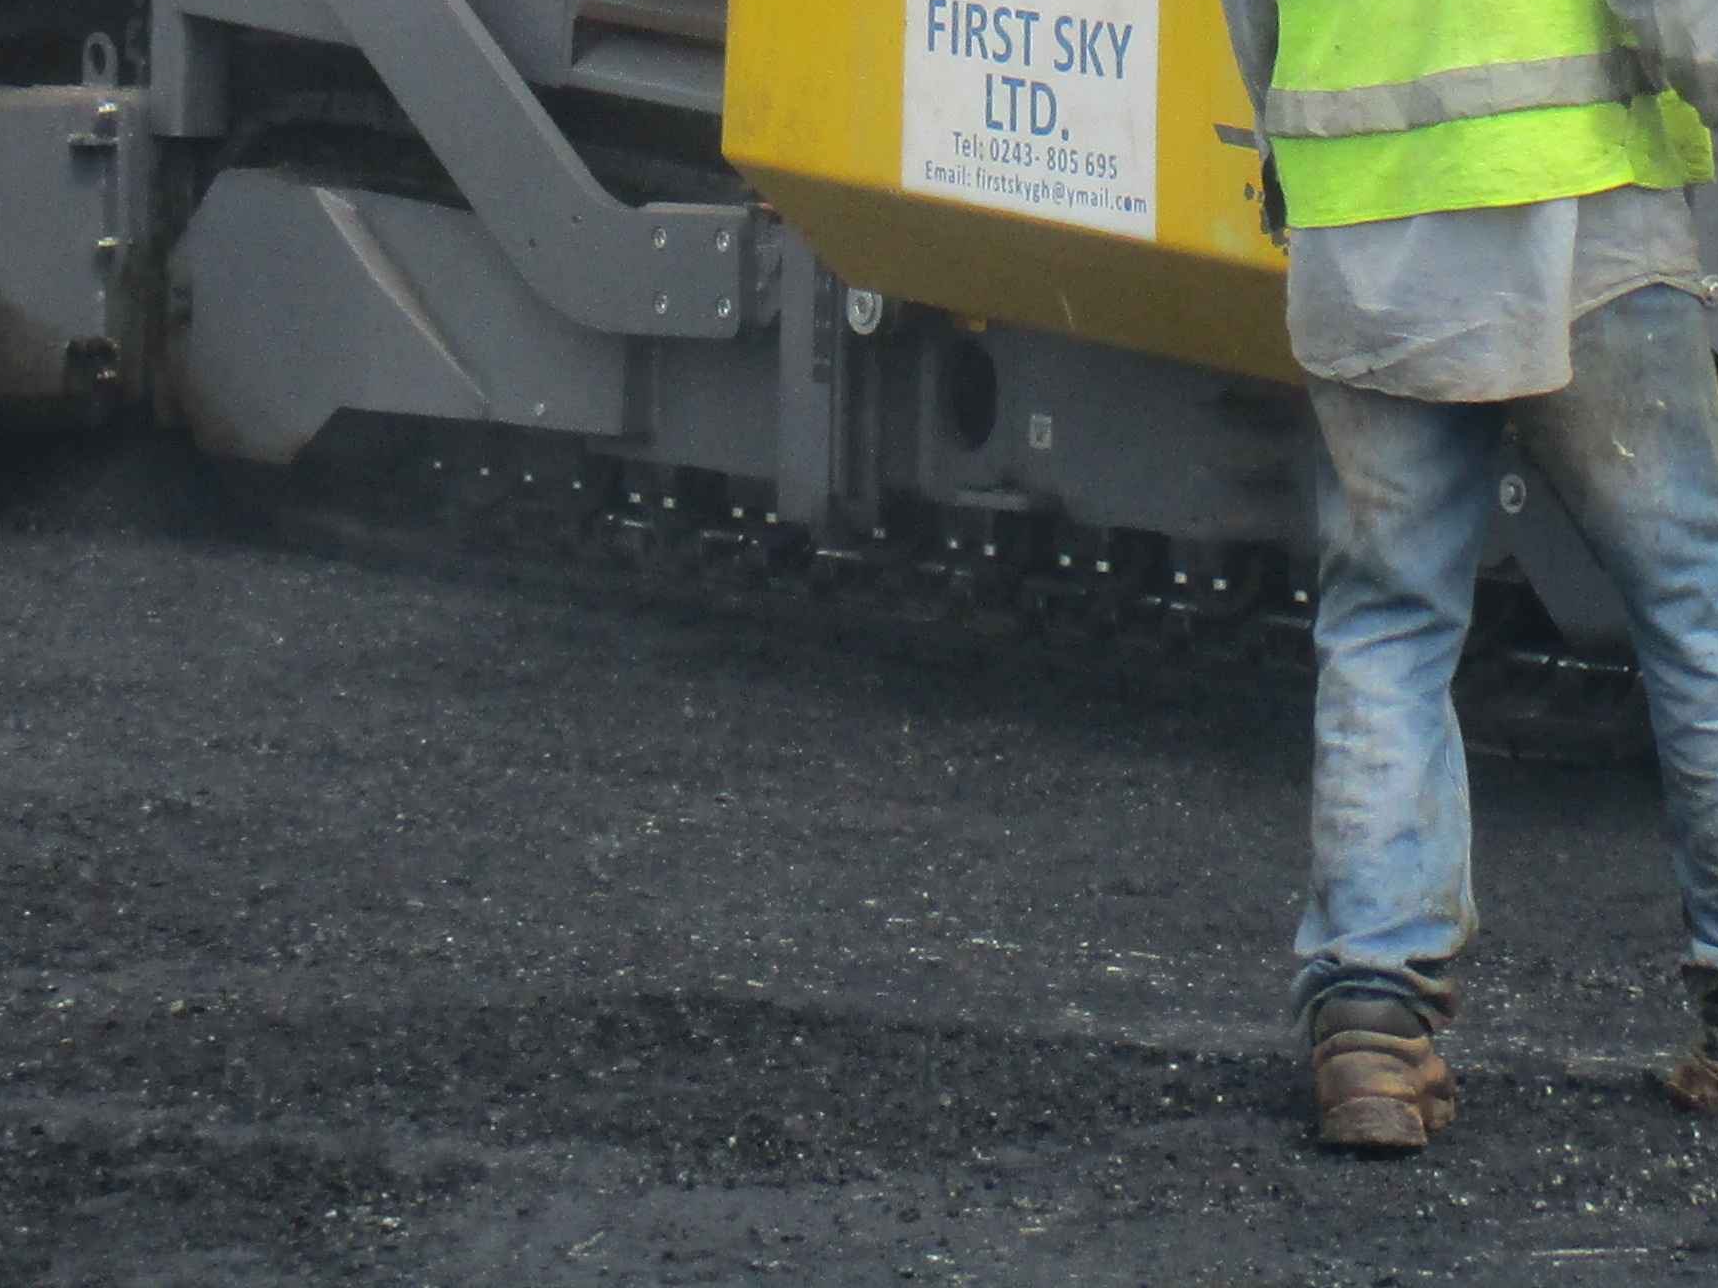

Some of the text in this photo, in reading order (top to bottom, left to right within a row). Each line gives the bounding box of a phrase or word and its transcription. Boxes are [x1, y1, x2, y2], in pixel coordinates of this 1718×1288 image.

[1053, 15, 1133, 79] SKY
[984, 72, 1070, 142] LTD.
[925, 160, 972, 186] Email:
[953, 131, 984, 162] Tel:
[1046, 146, 1079, 174] 805
[1085, 154, 1118, 180] 695
